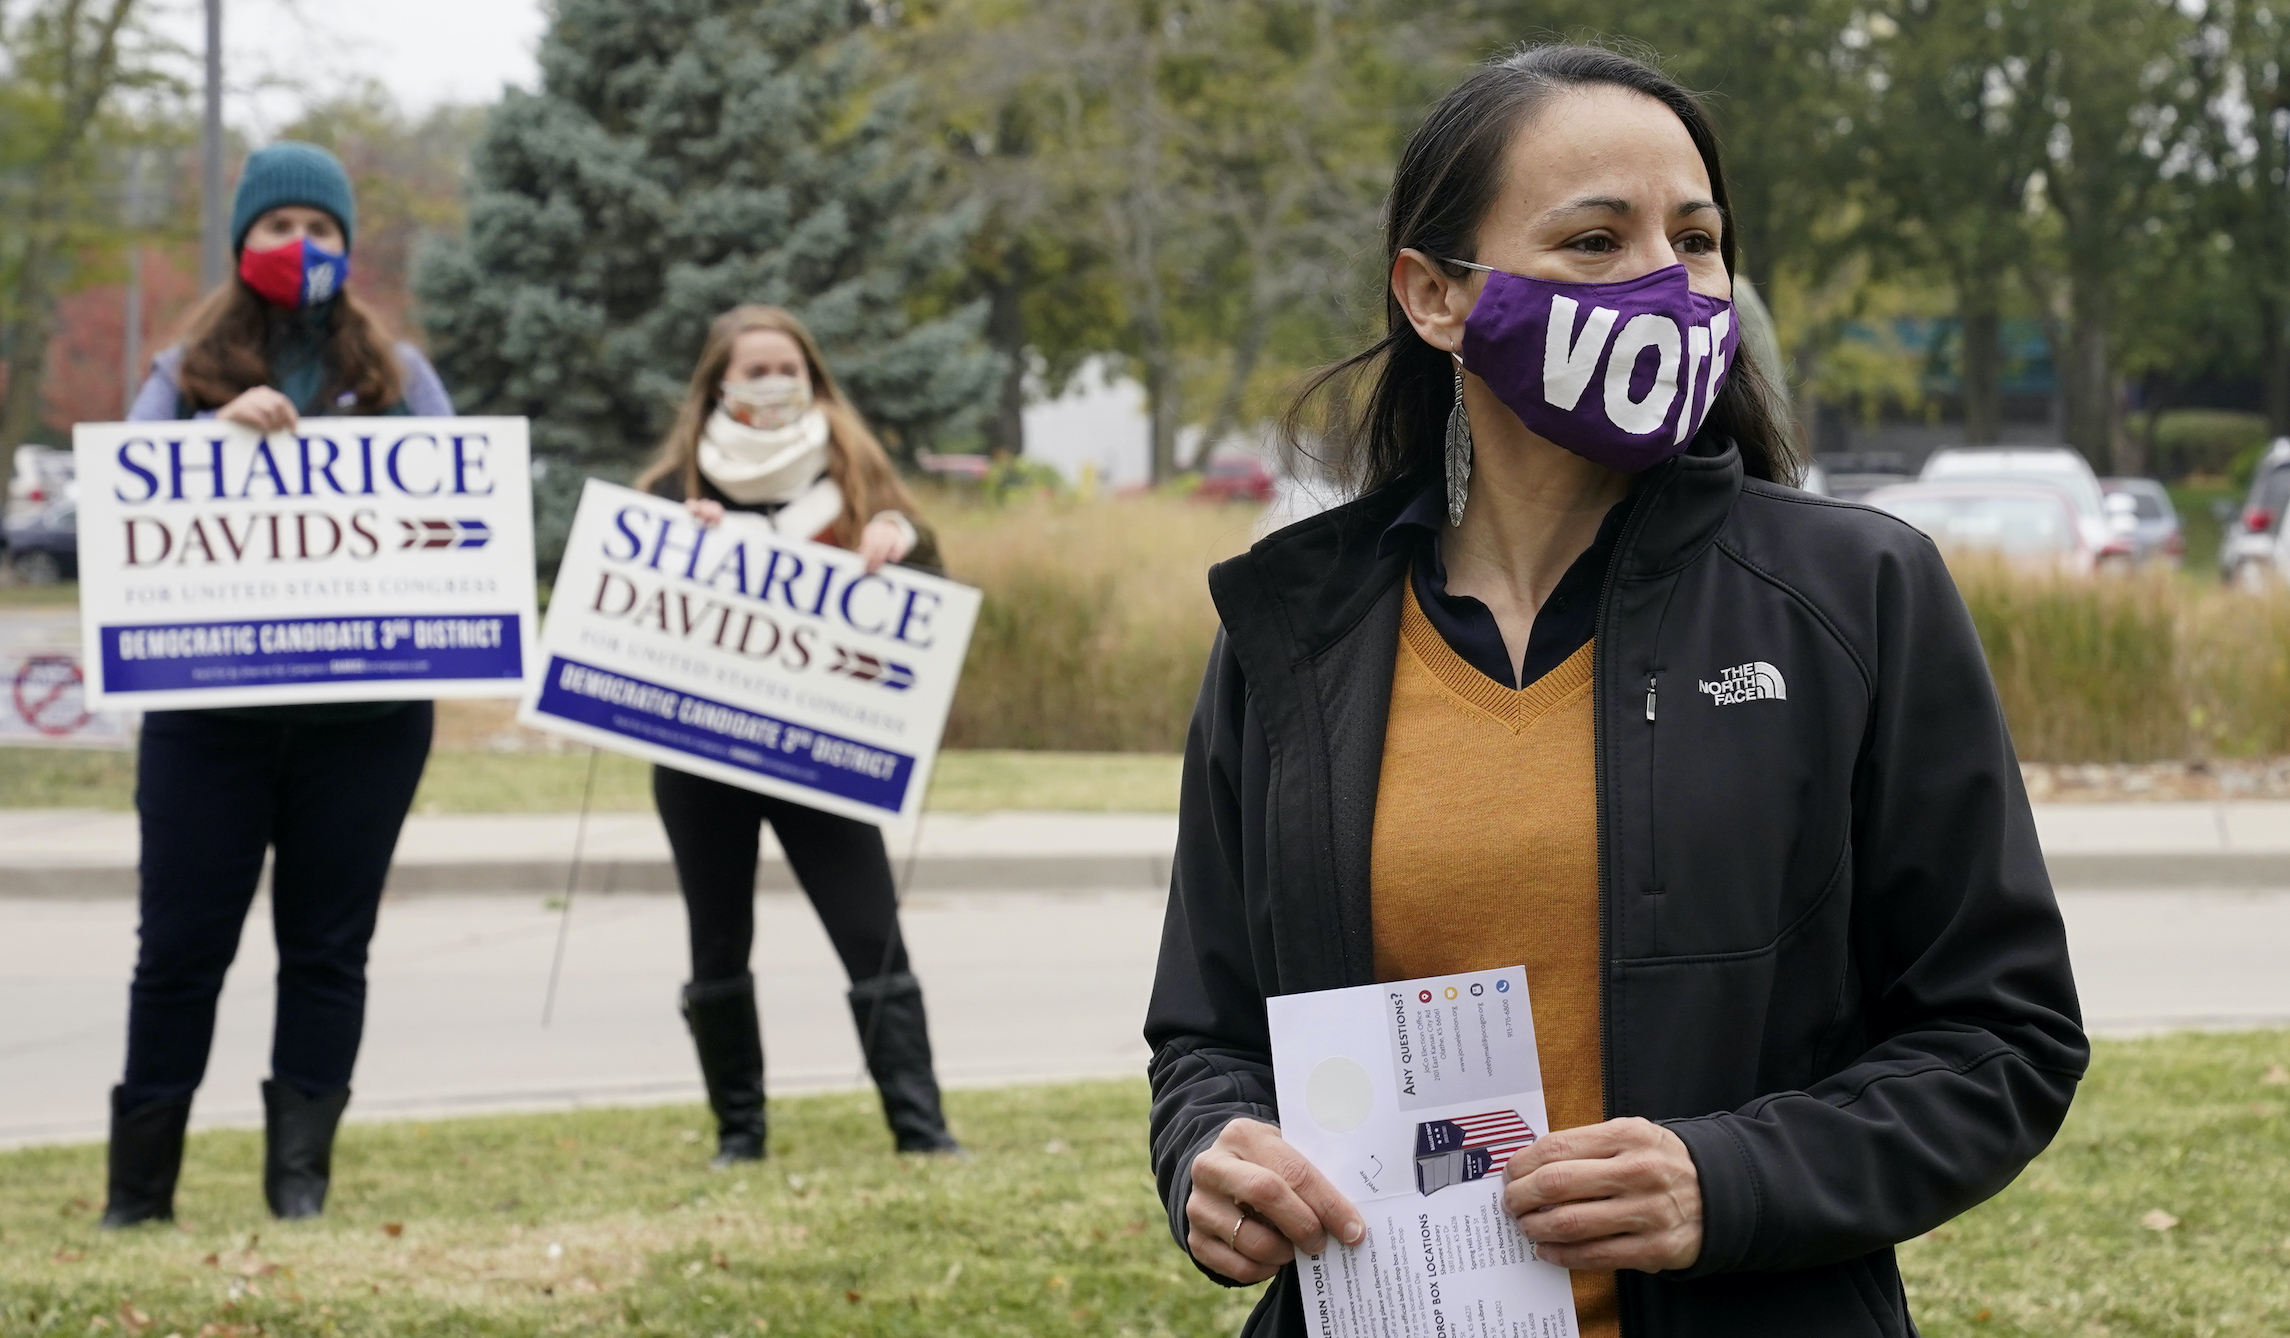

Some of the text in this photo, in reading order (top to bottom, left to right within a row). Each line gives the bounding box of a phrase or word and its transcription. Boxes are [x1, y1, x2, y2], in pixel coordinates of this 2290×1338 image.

[1543, 294, 1730, 446] VOTE
[115, 432, 495, 504] SHARICE
[122, 508, 380, 569] DAVIDS
[602, 503, 943, 650] SHARICE
[125, 575, 498, 605] FOR UNITED STATES CONGRESS
[589, 570, 819, 673] DAVIDS
[119, 623, 256, 660] DEMOCRATIC
[259, 619, 377, 656] CANDIDATE
[414, 618, 503, 650] DISTRICT
[581, 627, 907, 735] FOR UNITED STATES CONGRESS
[1720, 662, 1755, 681] THE
[1698, 675, 1756, 695] NORTH
[1714, 687, 1756, 706] FACE
[559, 662, 677, 721] DEMOCRATIC
[678, 692, 781, 750] CANDIDATE
[812, 732, 898, 782] DISTRICT
[1424, 1009, 1431, 1018] Rd
[1502, 998, 1513, 1038] 913-715-6800
[1390, 992, 1415, 1095] ANY QUESTIONS?
[1415, 1010, 1431, 1073] JoCo Election Office
[1433, 1008, 1446, 1059] Olathe, KS 66061
[1451, 1005, 1465, 1073] www.jocoelection.org
[1477, 1002, 1492, 1077] votebymail@jocogov.org
[1427, 1134, 1435, 1150] BALLOT
[1359, 1170, 1379, 1193] peel here
[1364, 1226, 1374, 1248] ballots
[1442, 1225, 1449, 1233] Dr
[1453, 1233, 1459, 1242] KS
[1474, 1225, 1482, 1252] Webster
[1482, 1224, 1489, 1233] KS
[1491, 1191, 1508, 1265] JoCo Northeast Offices
[1445, 1233, 1454, 1259] Johnson
[1487, 1246, 1495, 1267] Spring
[1508, 1247, 1516, 1264] 6000
[1322, 1262, 1330, 1280] ballot
[1438, 1247, 1446, 1275] Shawnee
[1469, 1249, 1477, 1270] Spring
[1312, 1264, 1324, 1295] YOUR
[1372, 1263, 1381, 1288] Election
[1418, 1213, 1446, 1338] DROP BOX LOCATIONS
[1354, 1277, 1362, 1302] advance
[1377, 1289, 1382, 1298] on
[1385, 1286, 1394, 1307] polling
[1407, 1283, 1415, 1312] locations
[1416, 1285, 1424, 1310] Election
[1329, 1309, 1338, 1335] required
[1349, 1300, 1357, 1325] advance
[1399, 1302, 1408, 1324] official
[1420, 1311, 1426, 1320] on
[1477, 1299, 1485, 1321] Library
[1497, 1317, 1503, 1326] KS
[1549, 1313, 1555, 1321] St
[1557, 1307, 1566, 1336] KS 66030
[1381, 1316, 1390, 1337] polling
[1390, 1328, 1398, 1337] off
[1404, 1325, 1409, 1333] an
[1467, 1322, 1473, 1331] KS
